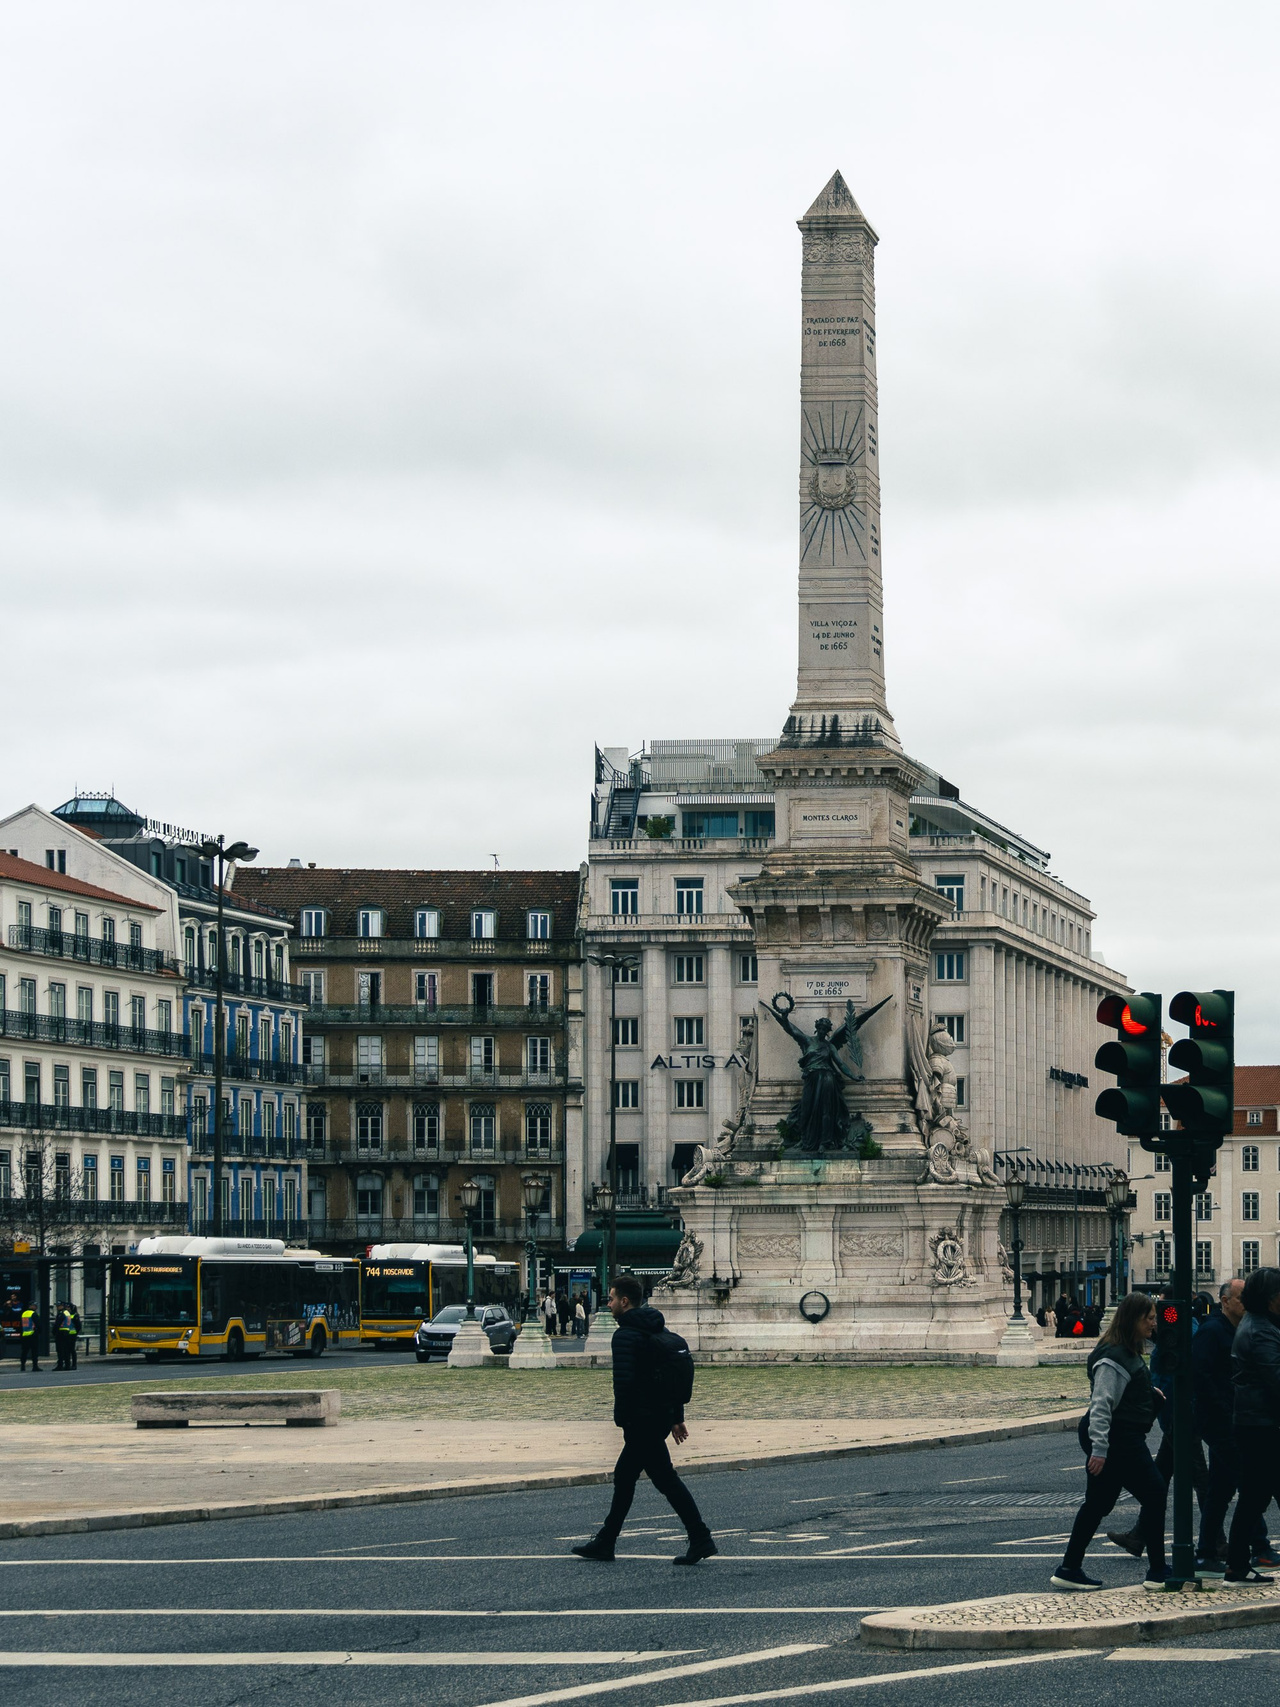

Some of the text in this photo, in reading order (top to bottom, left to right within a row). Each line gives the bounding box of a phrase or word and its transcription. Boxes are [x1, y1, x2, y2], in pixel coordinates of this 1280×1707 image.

[806, 317, 835, 325] TRATADO
[804, 328, 812, 336] 13
[823, 328, 861, 336] FEVEREIRO
[829, 338, 847, 347] 1668
[831, 620, 858, 628] VIÇOZA
[812, 632, 820, 640] 14
[831, 641, 848, 650] 1665
[802, 814, 859, 822] MONTES CLAROS
[806, 981, 814, 990] 17
[824, 987, 843, 996] 1665
[650, 1054, 716, 1069] ALTIS
[123, 1264, 183, 1275] 722 RESTAURADORES
[365, 1267, 415, 1277] 744 MOSCAVIDE
